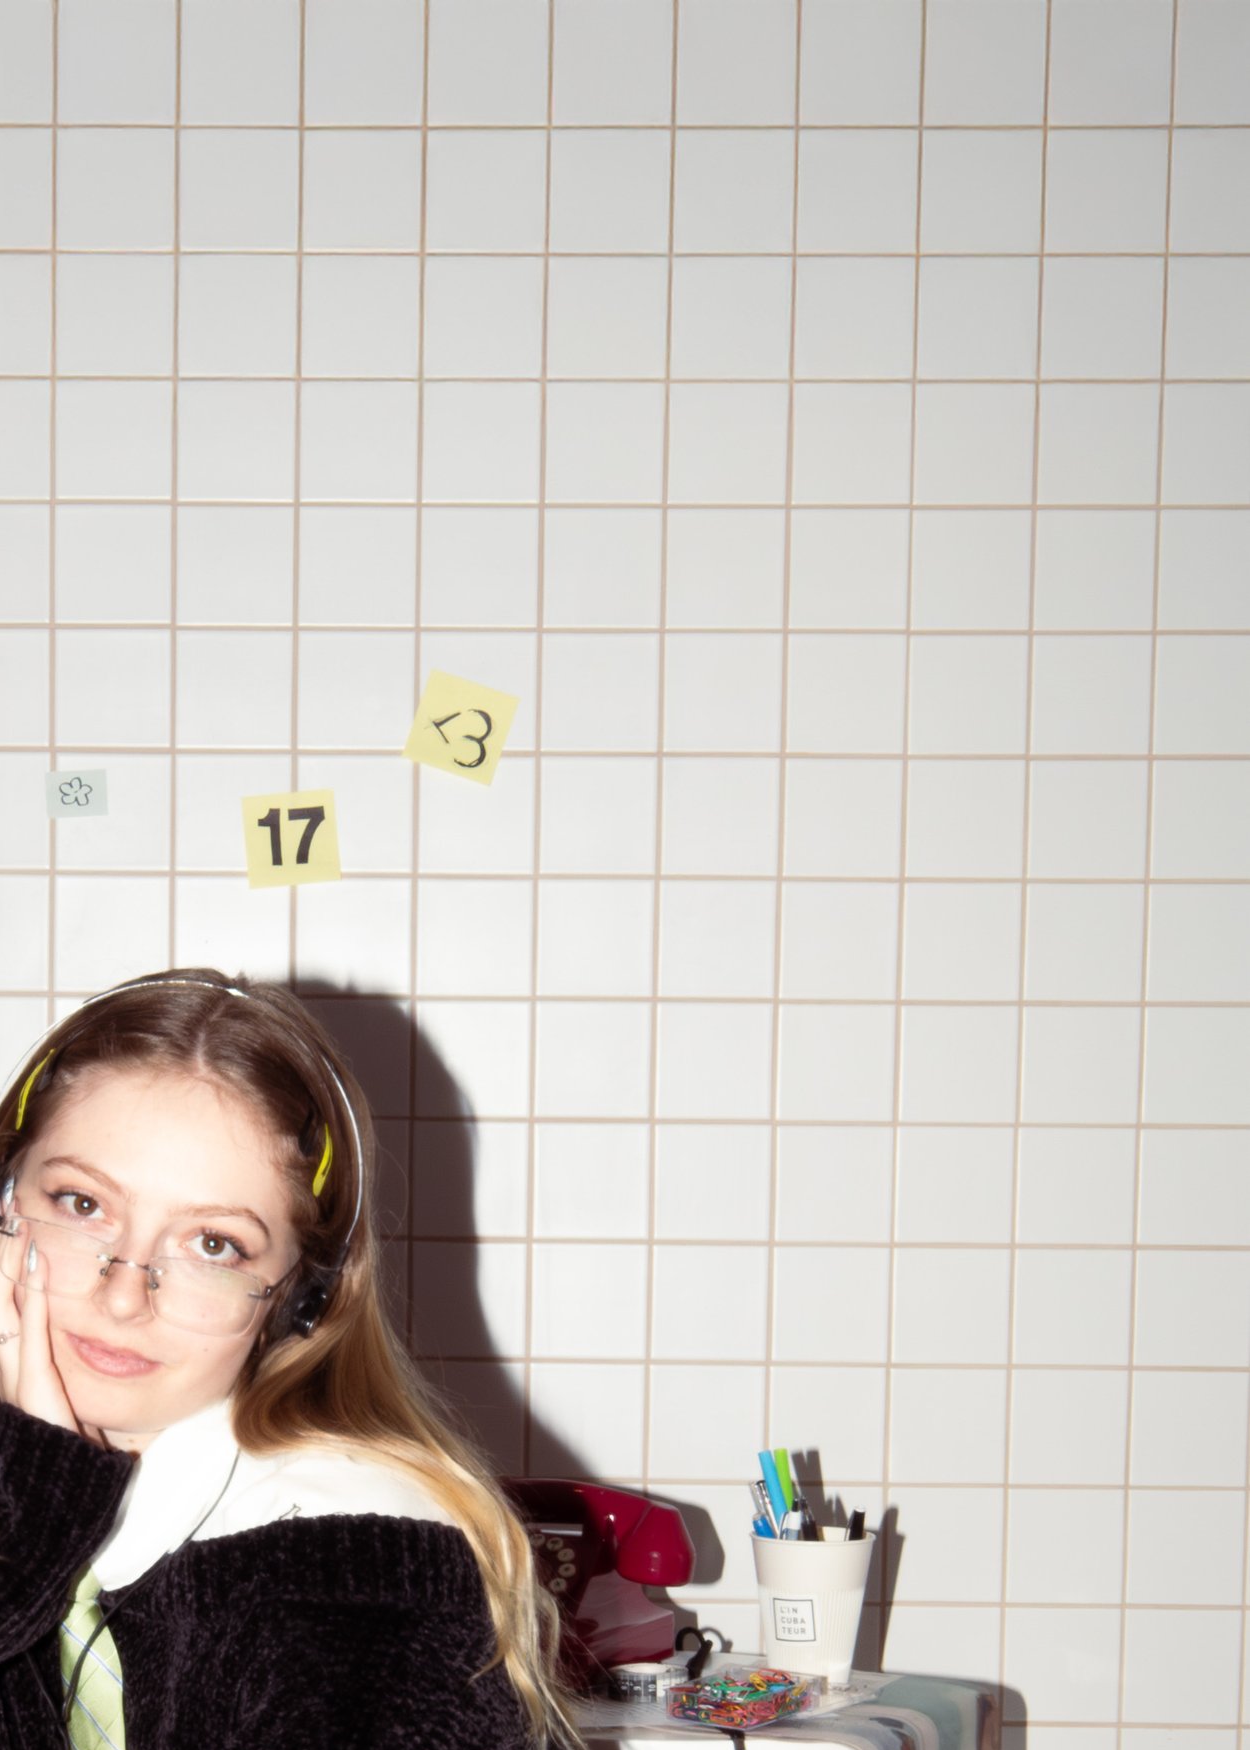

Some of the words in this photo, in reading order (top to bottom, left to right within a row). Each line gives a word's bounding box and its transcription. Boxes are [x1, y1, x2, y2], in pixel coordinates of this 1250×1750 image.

[257, 805, 326, 866] 17
[780, 1616, 807, 1625] CUBA
[781, 1626, 807, 1635] TEUR
